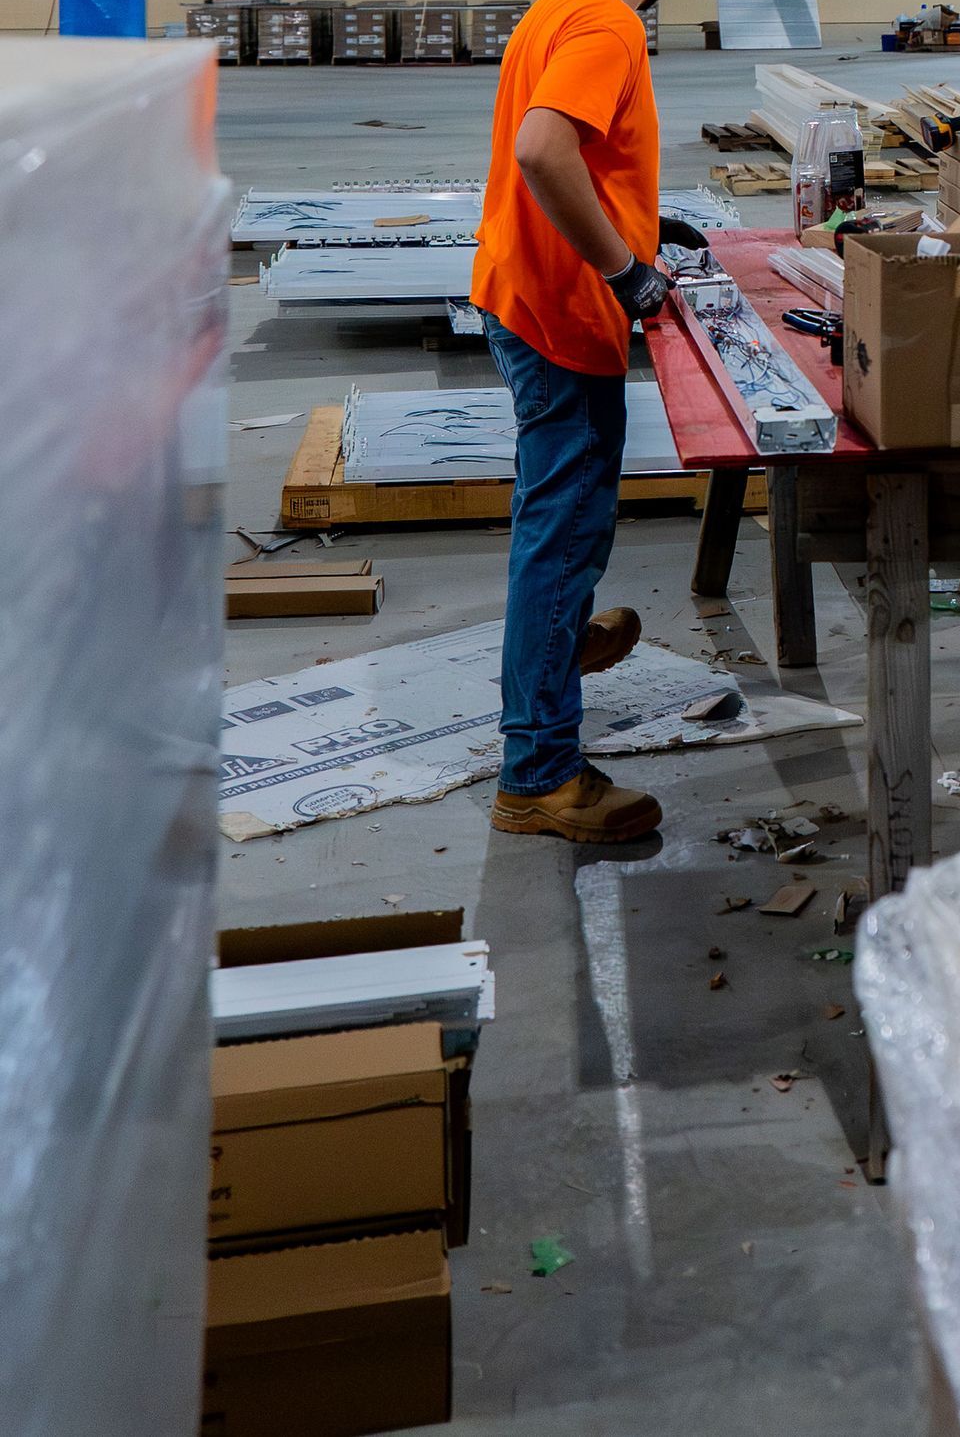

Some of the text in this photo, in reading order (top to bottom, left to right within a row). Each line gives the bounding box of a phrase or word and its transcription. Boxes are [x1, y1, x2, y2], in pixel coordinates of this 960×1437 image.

[299, 719, 401, 751] PRO
[247, 755, 356, 786] PERFORMANCE
[396, 721, 477, 746] INSULATION
[221, 756, 276, 781] Sika
[304, 787, 350, 808] COMPLETE
